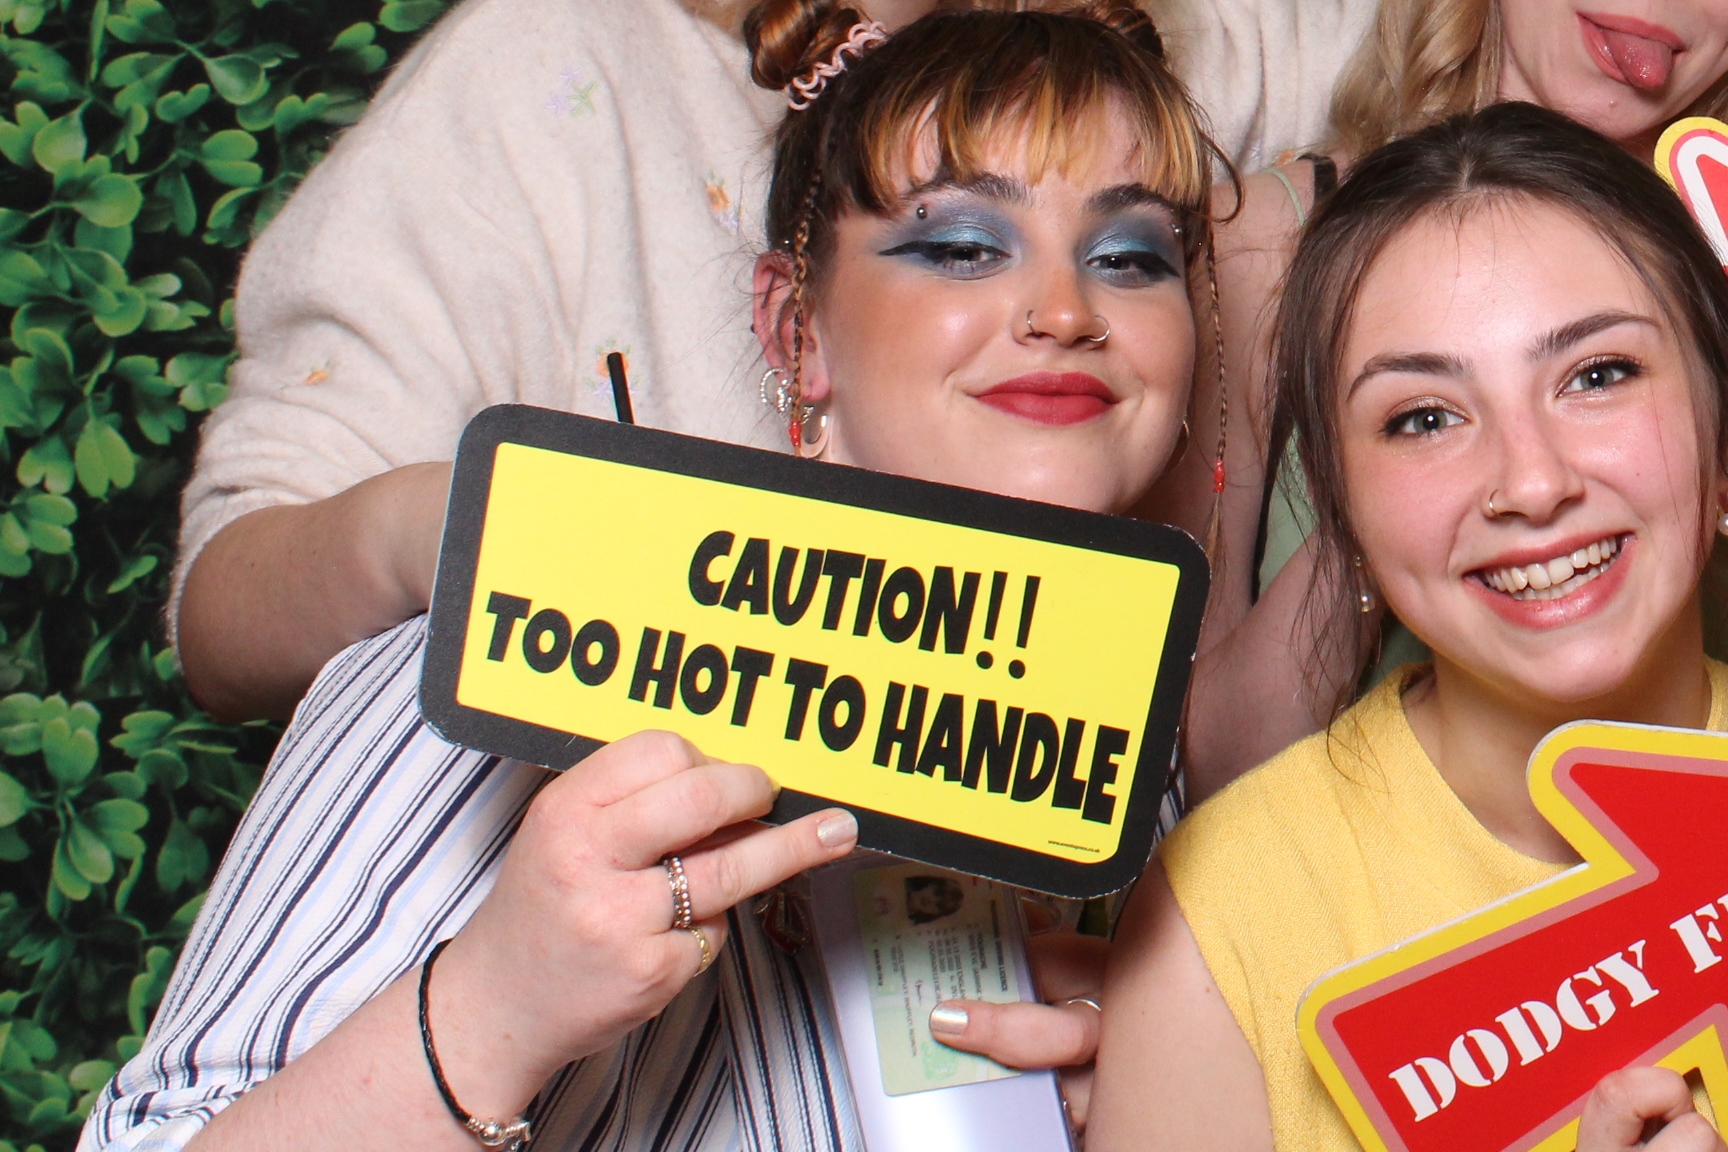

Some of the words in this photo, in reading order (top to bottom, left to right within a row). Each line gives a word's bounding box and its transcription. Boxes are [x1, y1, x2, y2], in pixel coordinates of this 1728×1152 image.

[688, 530, 1041, 680] CAUTION!!
[486, 591, 620, 687] TOO
[627, 626, 774, 727] HOT
[783, 657, 867, 753] TO
[872, 681, 1130, 826] HANDLE
[1388, 939, 1660, 1122] DODGY
